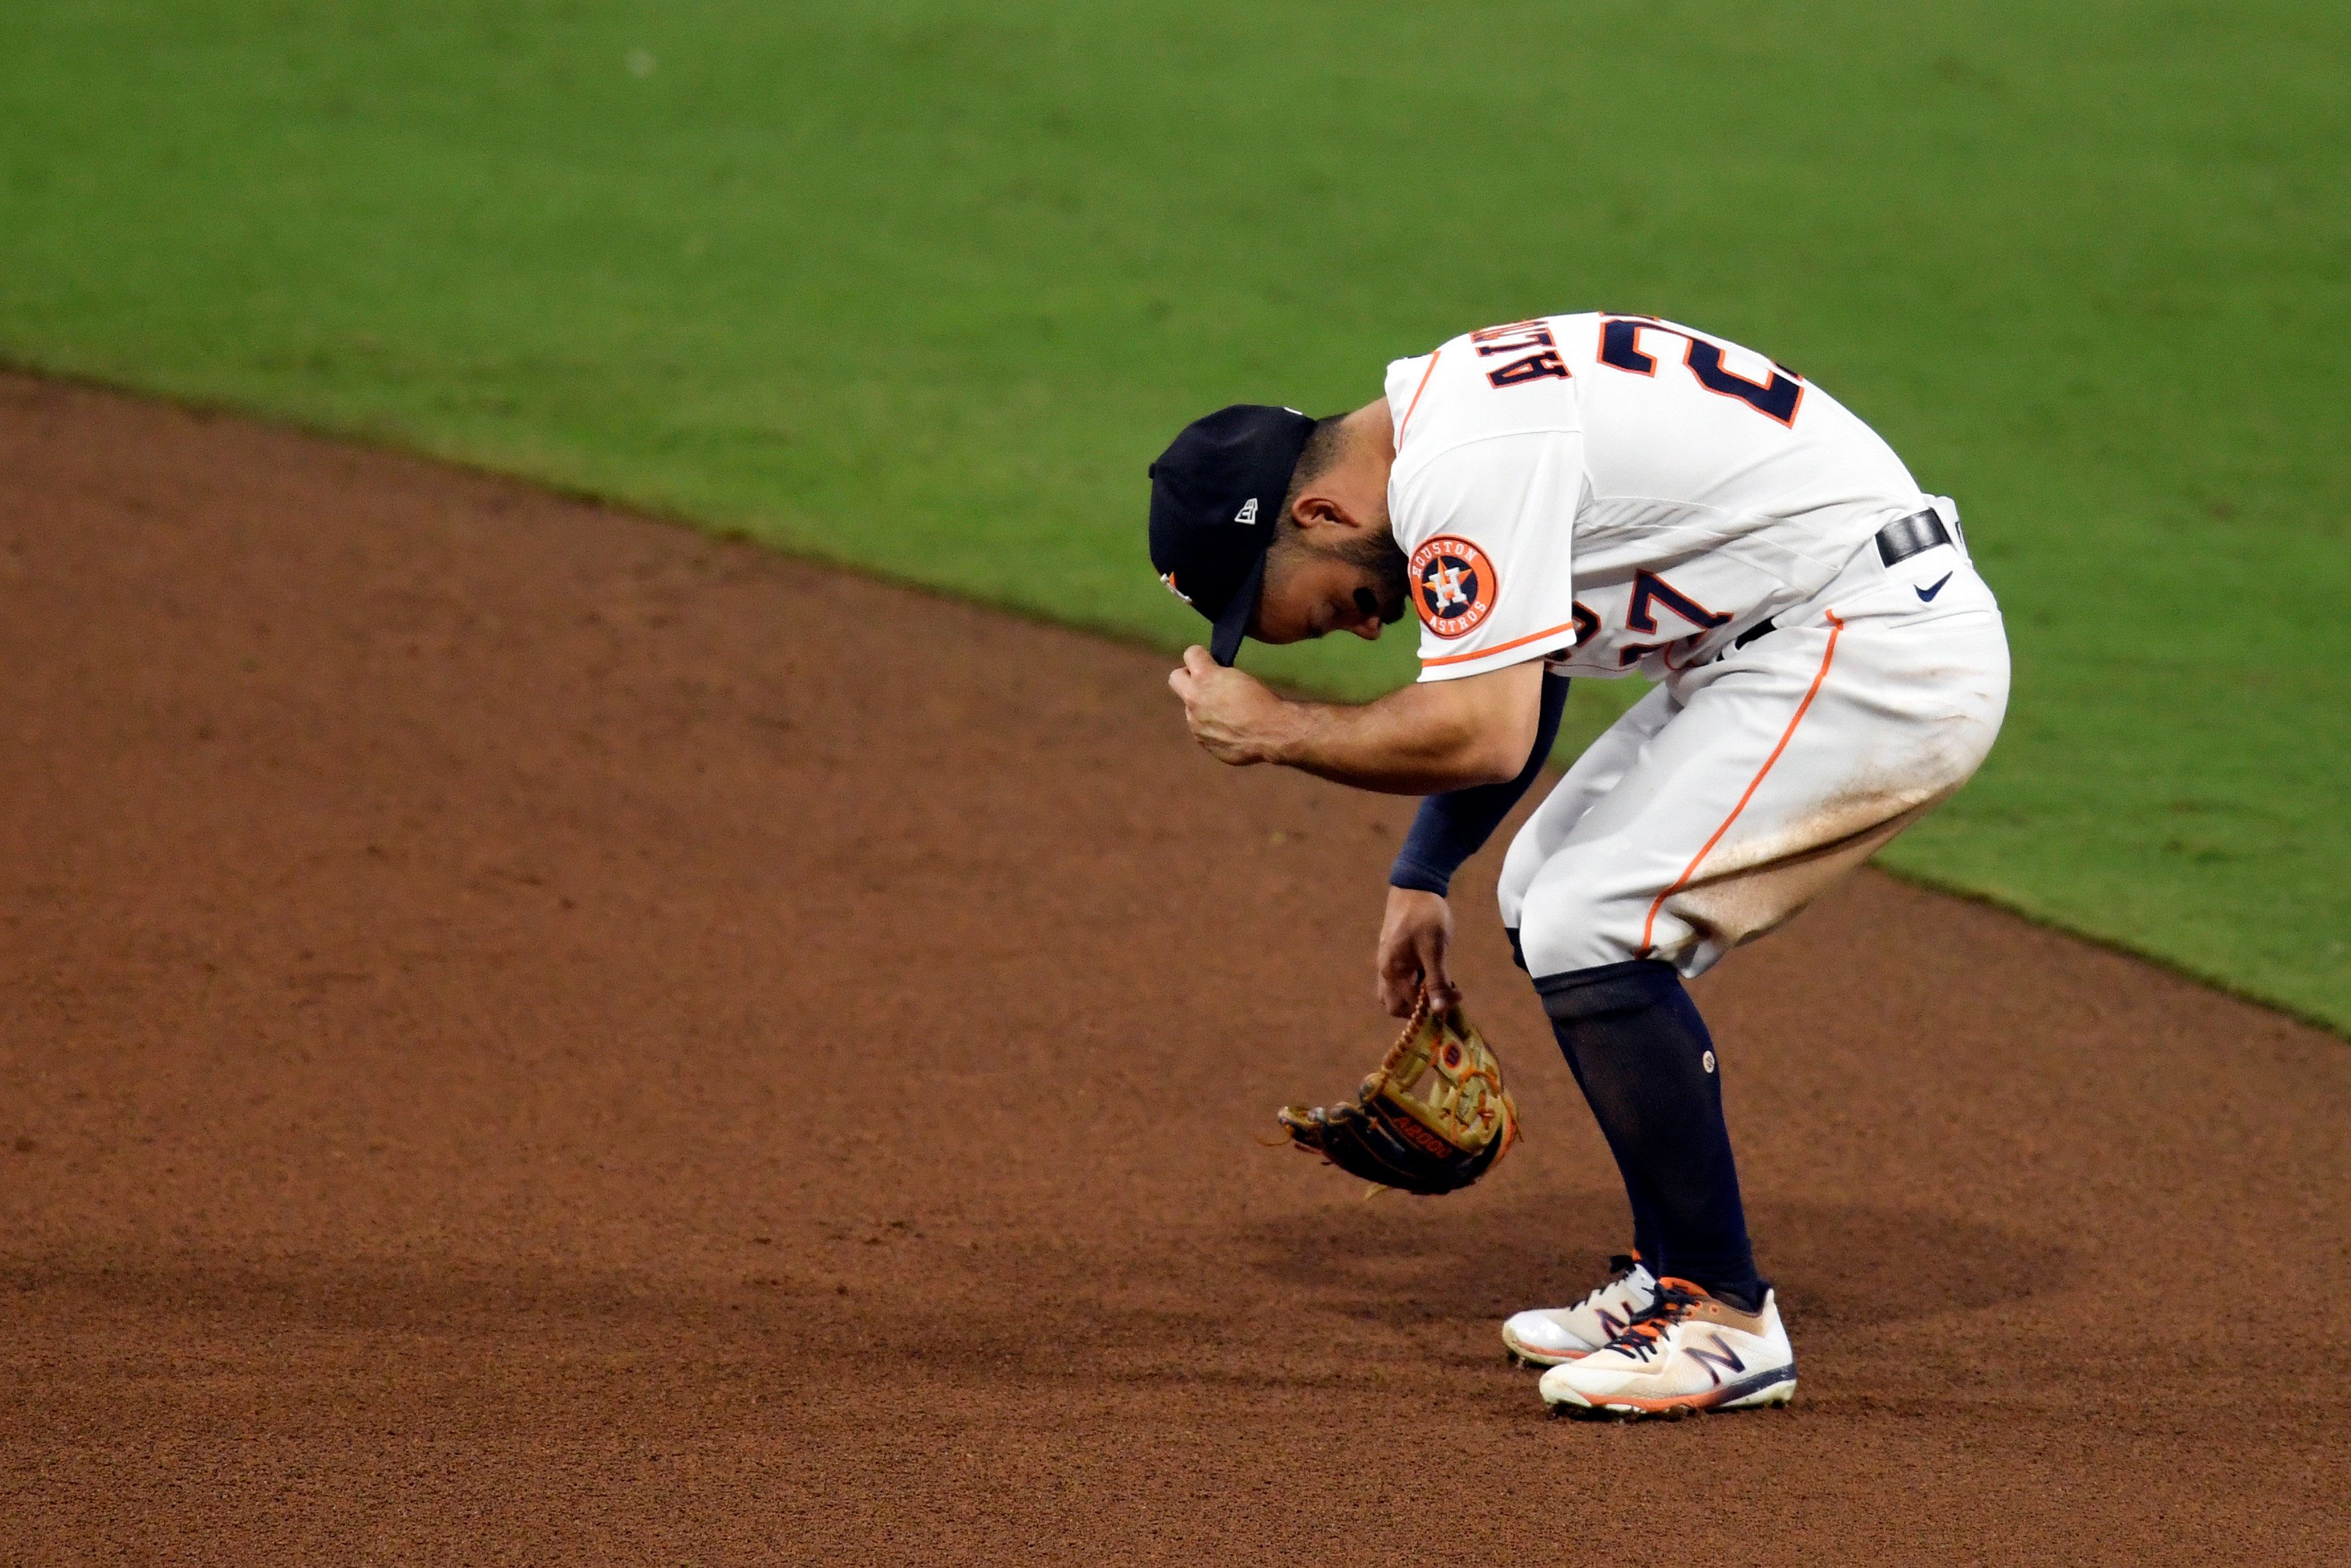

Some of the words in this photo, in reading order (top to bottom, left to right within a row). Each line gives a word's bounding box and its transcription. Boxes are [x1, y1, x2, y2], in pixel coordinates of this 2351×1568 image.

[1412, 541, 1477, 579] HOUSTON
[1428, 566, 1468, 602] H
[1429, 600, 1487, 633] ASTROS
[1684, 1333, 1745, 1387] N
